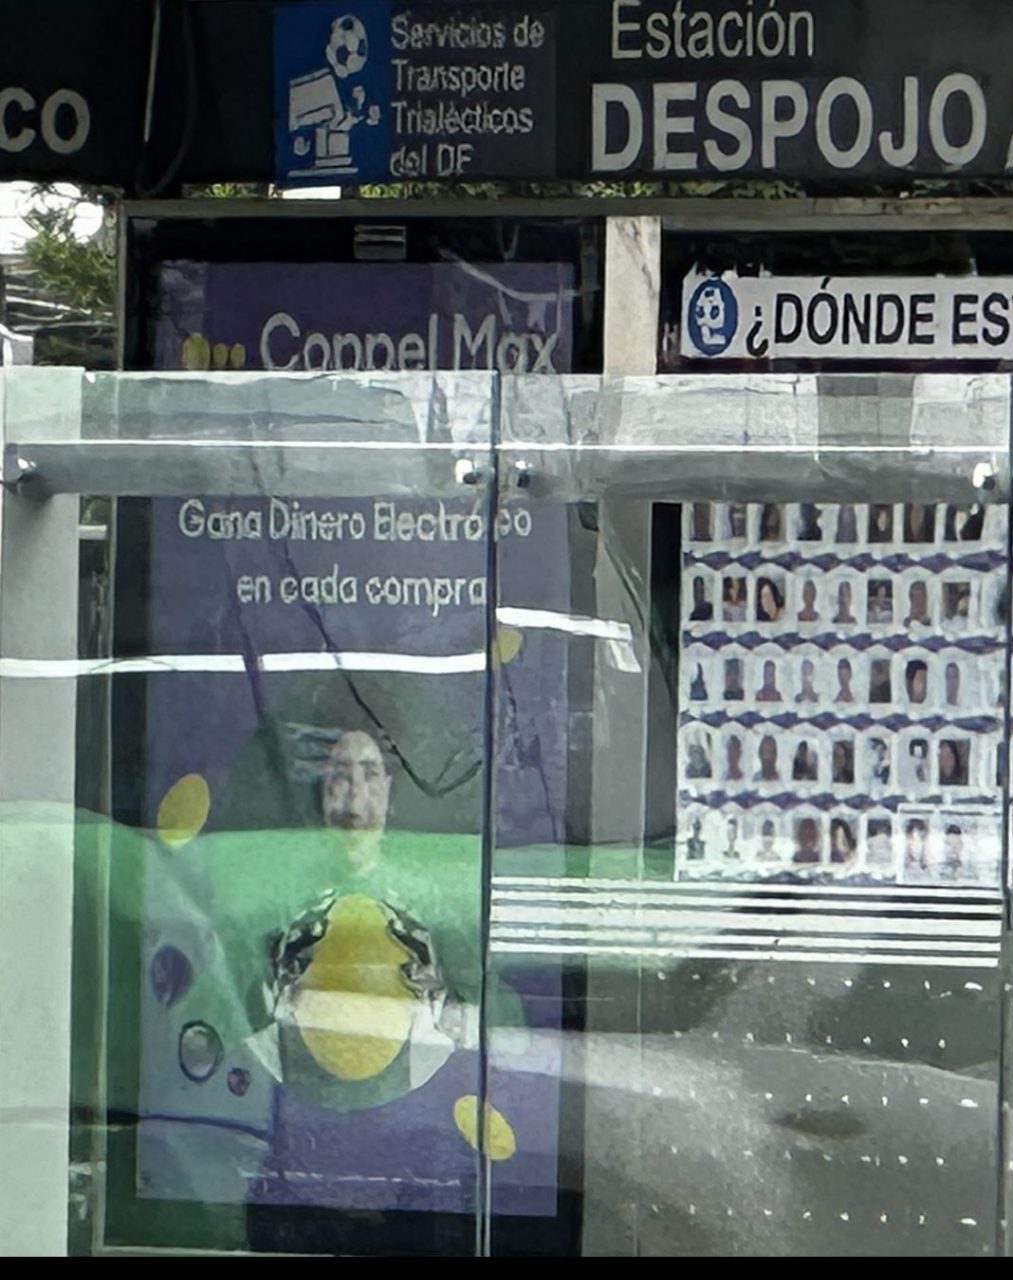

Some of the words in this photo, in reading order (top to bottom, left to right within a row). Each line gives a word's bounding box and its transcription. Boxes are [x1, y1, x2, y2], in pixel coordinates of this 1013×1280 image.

[390, 15, 506, 49] Servicios
[513, 15, 545, 48] de
[610, 0, 813, 59] Estación
[390, 58, 526, 97] Transporte
[591, 73, 988, 171] DESPOJO
[390, 144, 428, 177] del
[437, 143, 474, 177] DF
[453, 313, 560, 374] Max
[745, 278, 935, 358] ¿DÓNDE
[178, 499, 261, 539] Gana
[268, 497, 366, 541] Dinero
[236, 575, 271, 603] en
[280, 564, 358, 605] cada
[365, 575, 487, 616] compra
